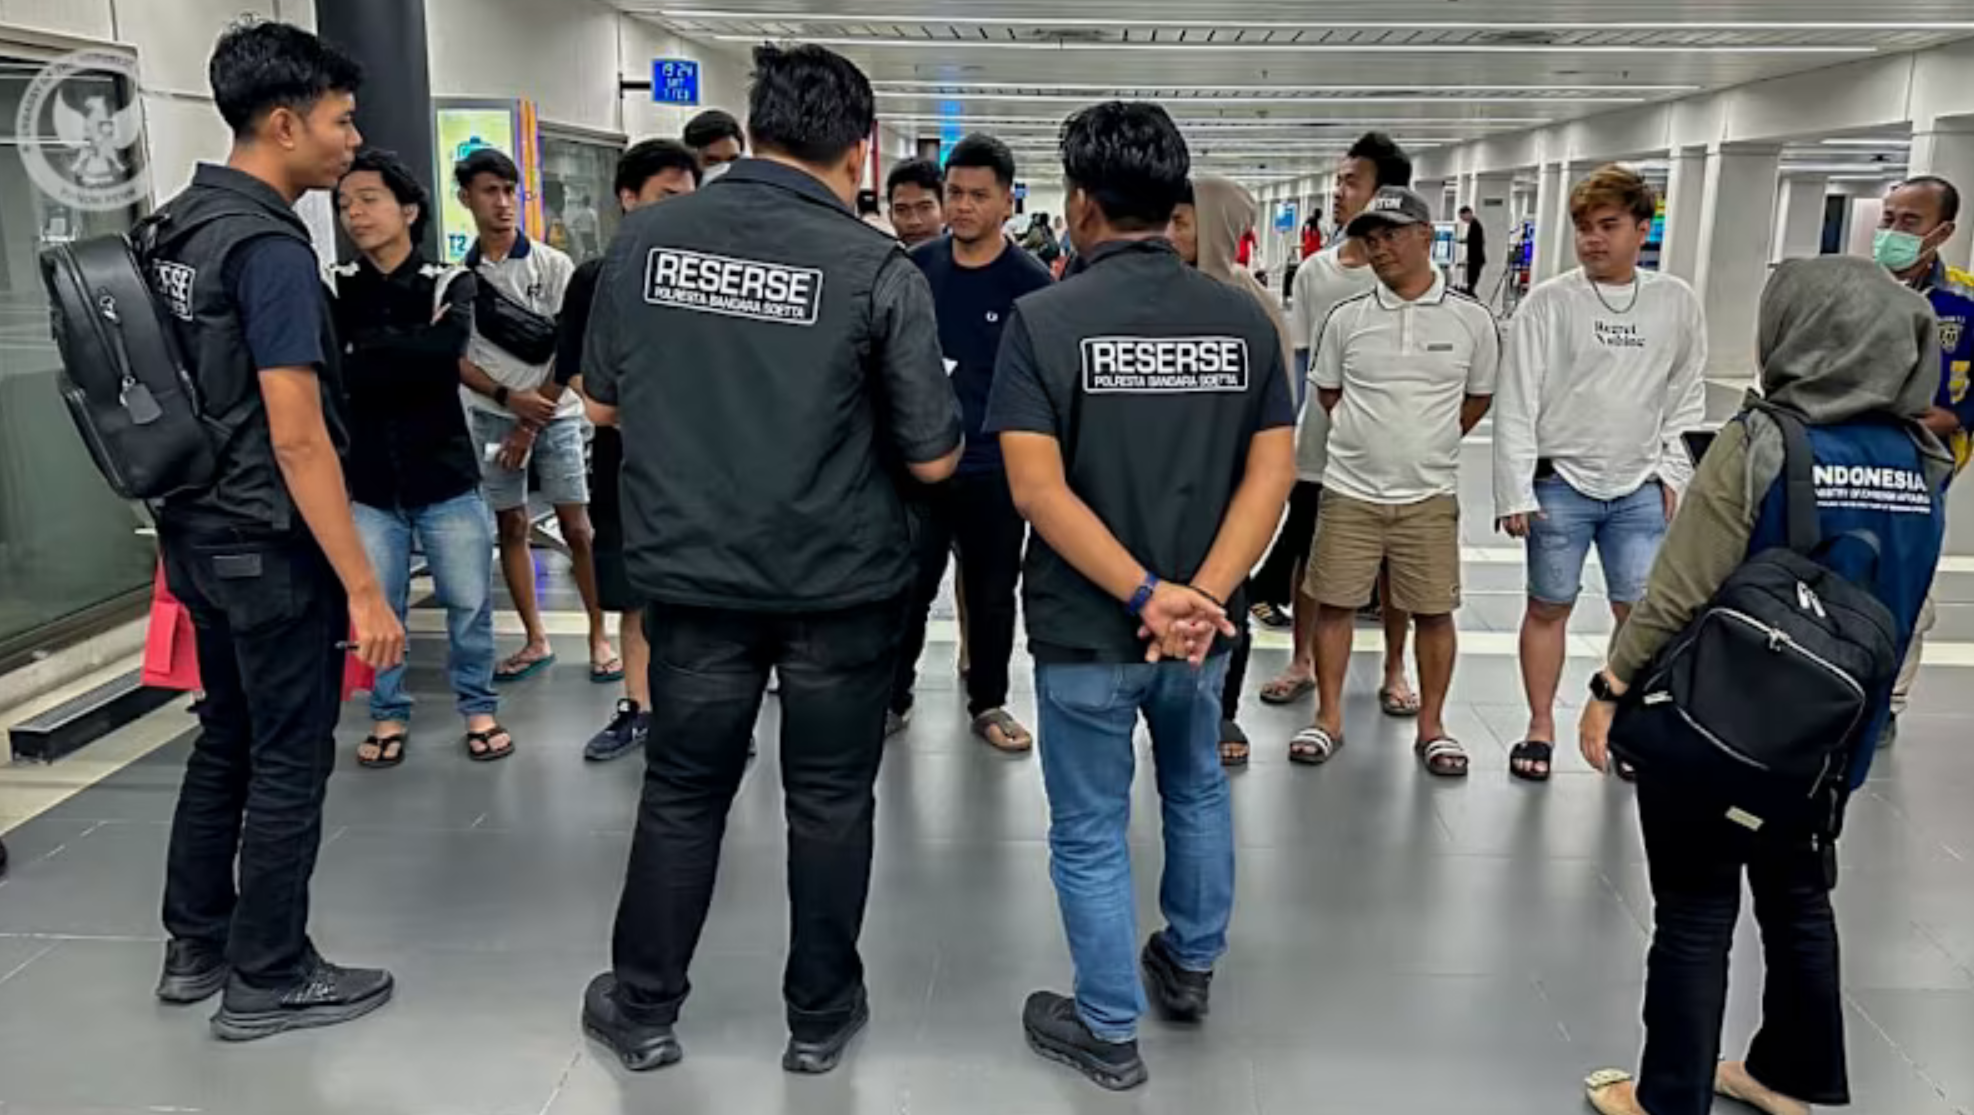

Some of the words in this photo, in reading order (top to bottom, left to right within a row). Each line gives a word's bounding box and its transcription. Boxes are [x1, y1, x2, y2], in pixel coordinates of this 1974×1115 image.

[655, 253, 811, 304] RESERSE
[1092, 342, 1240, 374] RESERSE
[1812, 464, 1928, 492] NDONESIA
